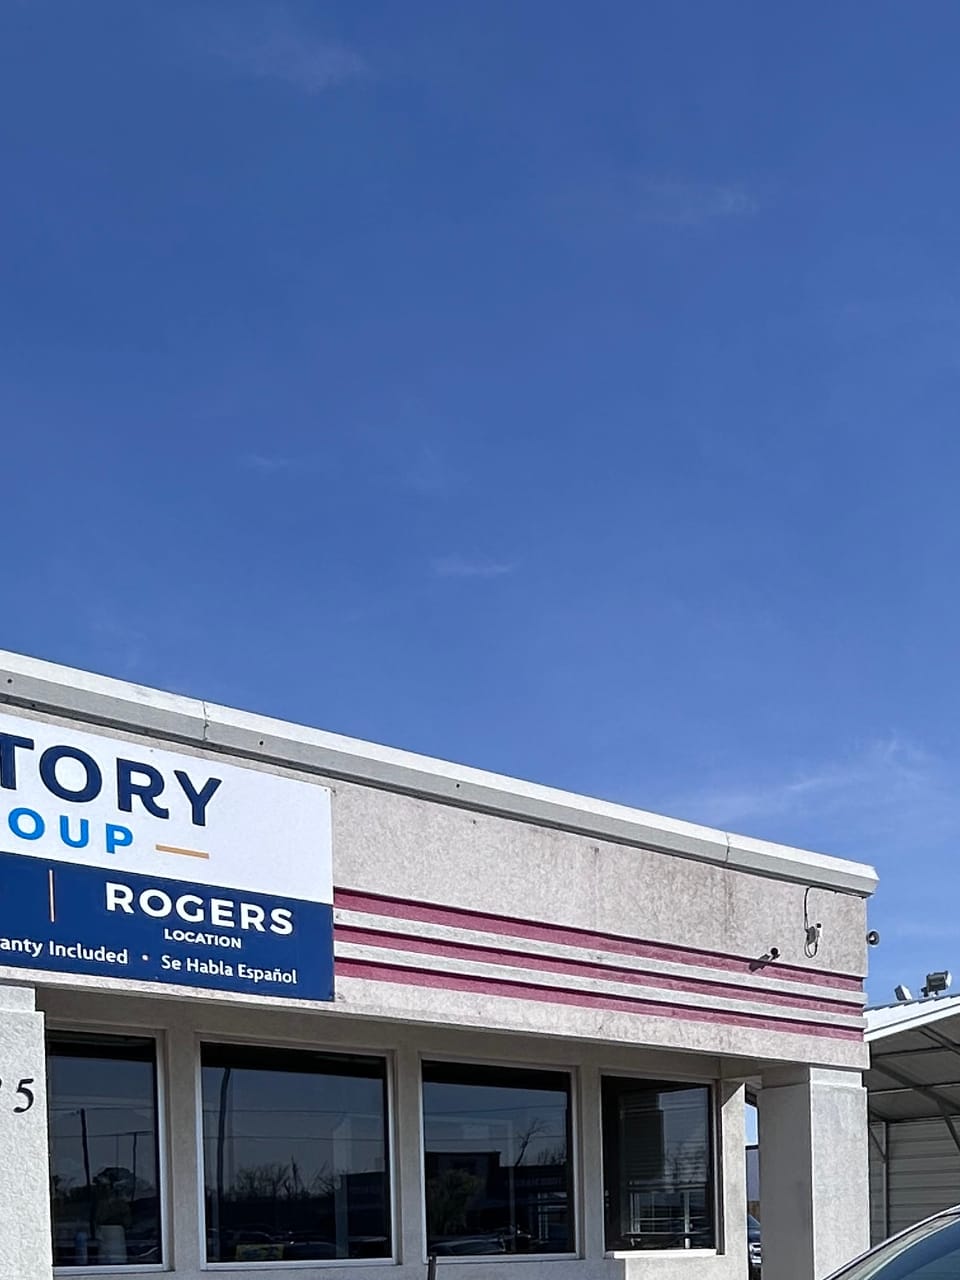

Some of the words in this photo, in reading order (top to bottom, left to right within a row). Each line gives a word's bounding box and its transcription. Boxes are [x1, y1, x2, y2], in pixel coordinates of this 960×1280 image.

[8, 807, 133, 854] OUP
[105, 882, 294, 936] ROGERS
[0, 937, 43, 958] anty
[49, 941, 129, 965] Included
[161, 954, 181, 971] Se
[186, 957, 234, 978] Habla
[238, 963, 298, 985] Español
[163, 928, 242, 949] LOCATION
